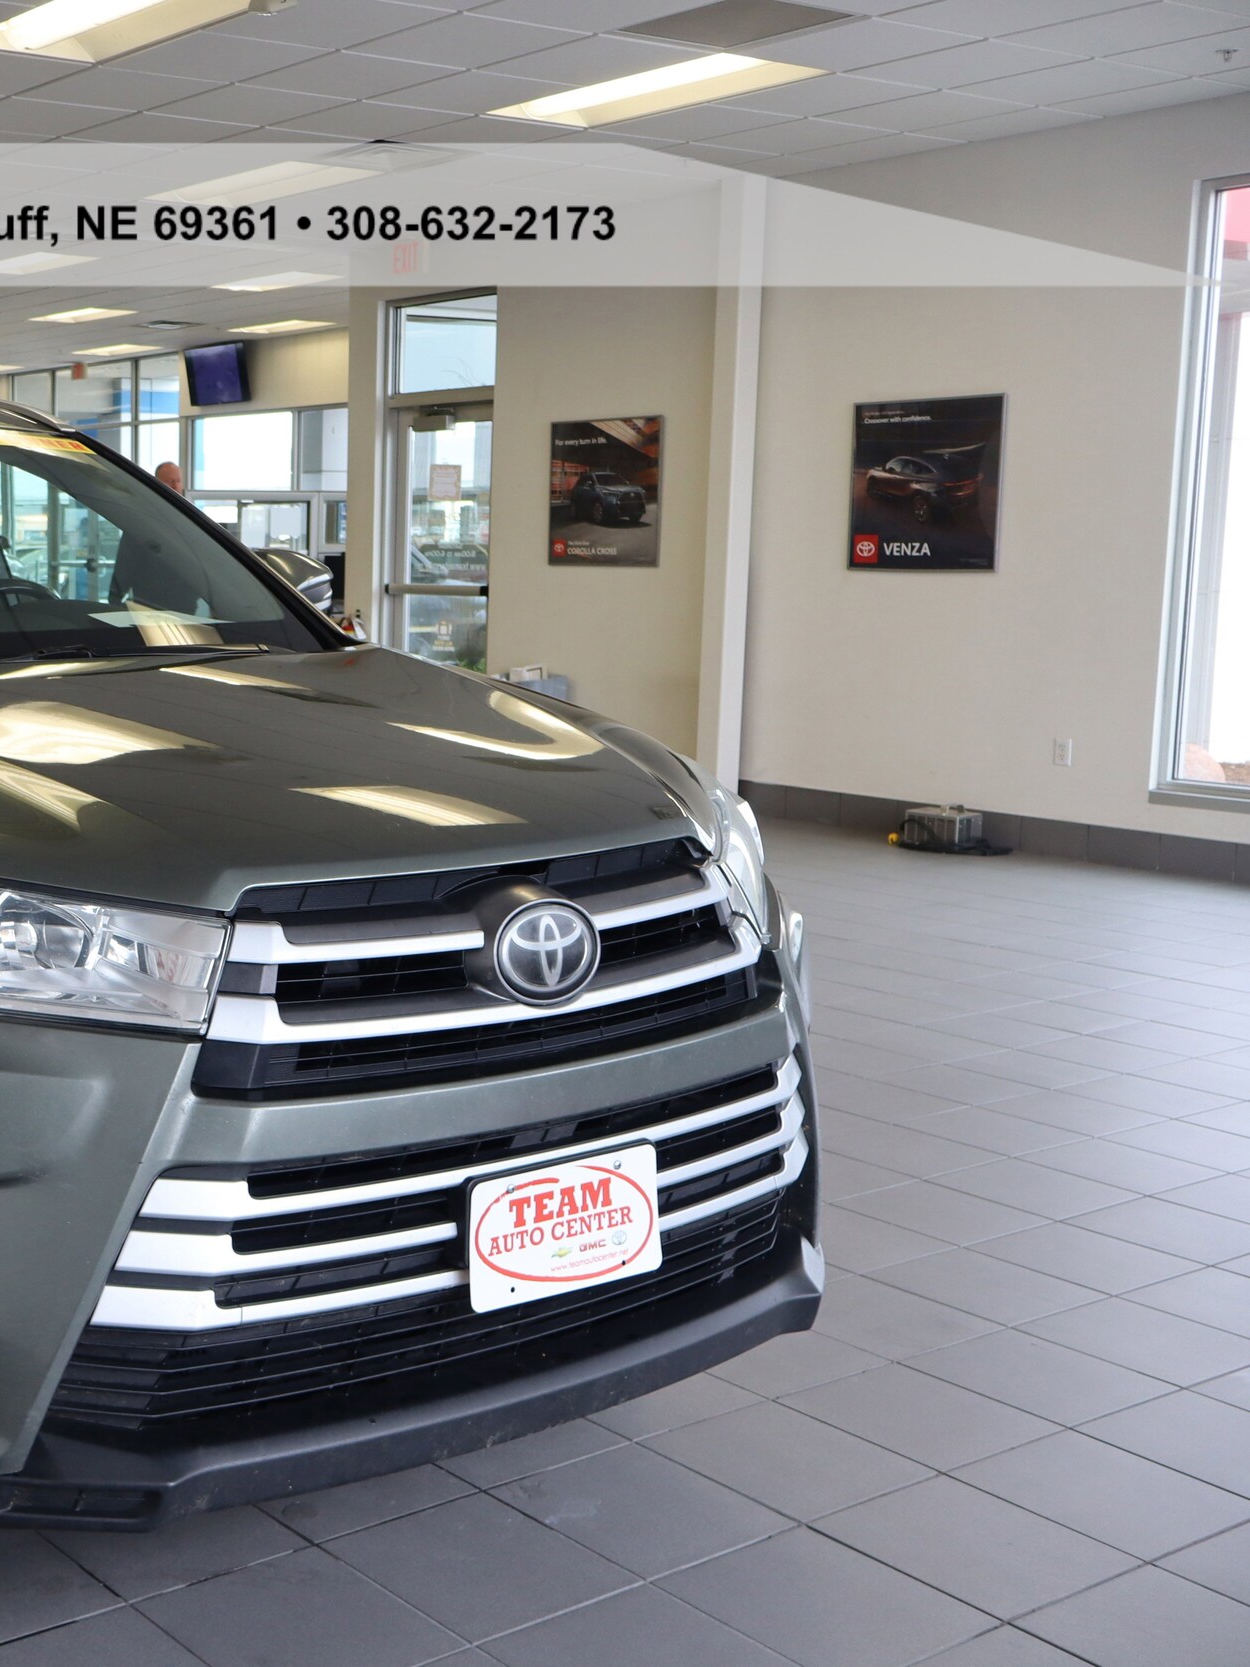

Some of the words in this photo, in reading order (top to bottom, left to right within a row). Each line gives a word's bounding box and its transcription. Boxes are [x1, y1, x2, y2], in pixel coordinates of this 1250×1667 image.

[393, 240, 419, 273] EXIT
[6, 434, 86, 451] NER
[564, 439, 579, 447] every
[567, 547, 596, 555] COROLLA
[596, 547, 618, 555] CROSS
[883, 542, 931, 557] VENZA
[509, 1176, 612, 1228] TEAM
[487, 1226, 545, 1257] AUTO
[551, 1205, 633, 1241] CENTER
[579, 1238, 607, 1253] GMC
